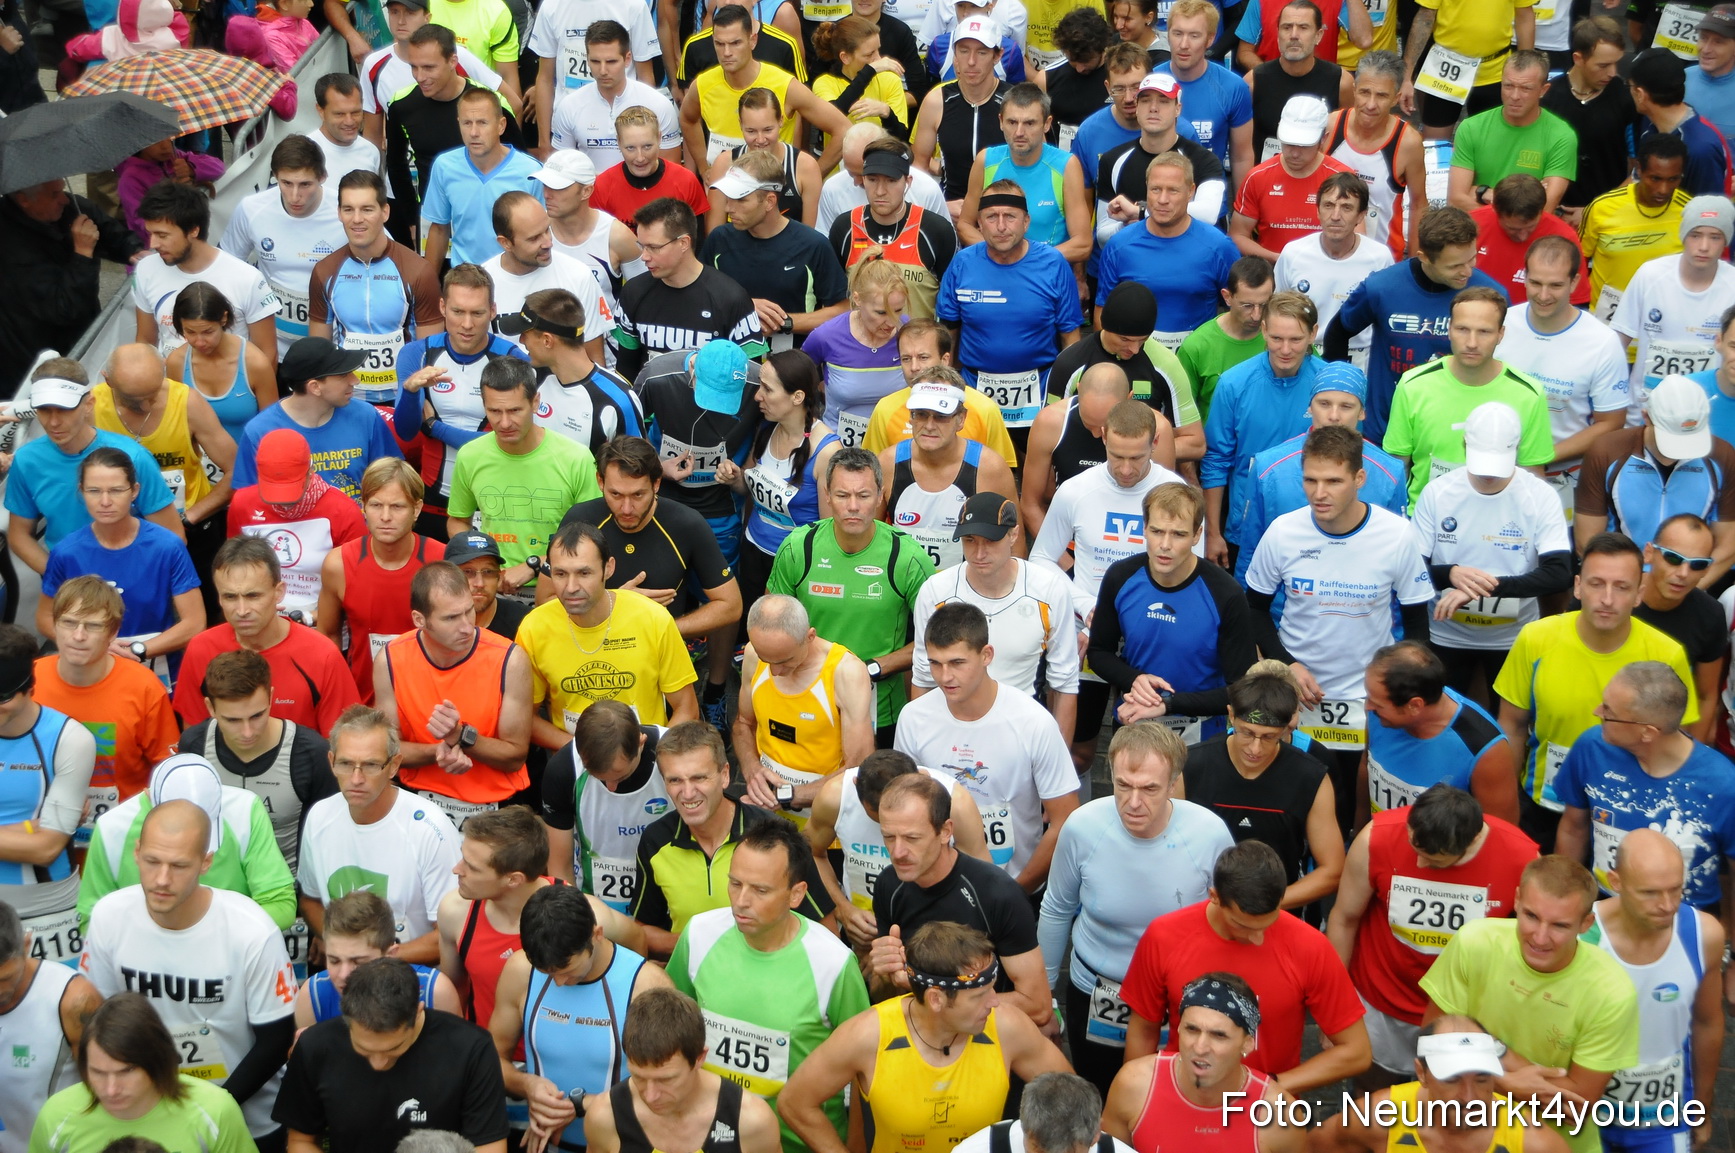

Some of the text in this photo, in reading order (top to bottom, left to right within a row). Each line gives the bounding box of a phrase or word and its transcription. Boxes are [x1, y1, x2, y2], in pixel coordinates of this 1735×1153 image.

[813, 7, 843, 17] Benjamin
[564, 47, 580, 56] PARTL
[1667, 40, 1694, 53] Sascha
[1438, 60, 1461, 82] 99
[1431, 79, 1454, 94] Stefan
[711, 137, 725, 145] PARTL
[1264, 142, 1281, 150] PARTL
[903, 269, 923, 283] AND
[345, 337, 394, 346] PARTL Neumarkt
[1648, 343, 1706, 356] PARTL Neumarkt
[1651, 355, 1710, 376] 2637
[360, 373, 394, 385] Andreas
[978, 376, 1029, 386] PARTL Neumarkt
[984, 384, 1031, 406] 2371
[841, 416, 860, 428] PARTL
[479, 485, 563, 520] OPF
[897, 512, 915, 522] tkn
[916, 535, 949, 544] Neumarkt
[285, 582, 312, 590] r.Röschl
[811, 584, 841, 594] OBI
[1319, 580, 1378, 590] Raiffeisenbank
[286, 589, 312, 597] iagnostik
[1334, 590, 1365, 598] Rothsee
[1146, 610, 1177, 623] skinfit
[1464, 615, 1493, 625] Anika
[576, 662, 619, 677] PIZZERIA
[570, 673, 626, 692] FRANCESCO
[1320, 701, 1350, 725] 52
[1312, 729, 1359, 743] Wolfgang
[774, 769, 809, 786] Neumarkt
[1379, 775, 1411, 795] Neumarkt
[446, 803, 483, 813] Neumarkt
[1593, 828, 1617, 842] PARTL
[593, 862, 620, 872] PARTL
[849, 857, 876, 869] PARTL
[959, 885, 975, 907] 2XU
[1392, 883, 1470, 901] PARTL Neumarkt
[1408, 897, 1466, 931] 236
[31, 919, 73, 933] Neumarkt
[1411, 931, 1449, 946] Torste
[119, 965, 224, 1004] THULE
[1098, 996, 1132, 1024] 22
[703, 1018, 773, 1044] PARTL Neumarkt
[715, 1036, 770, 1073] 455
[728, 1074, 751, 1089] Udo
[1602, 1073, 1676, 1104] 2798
[410, 1110, 427, 1122] Sid
